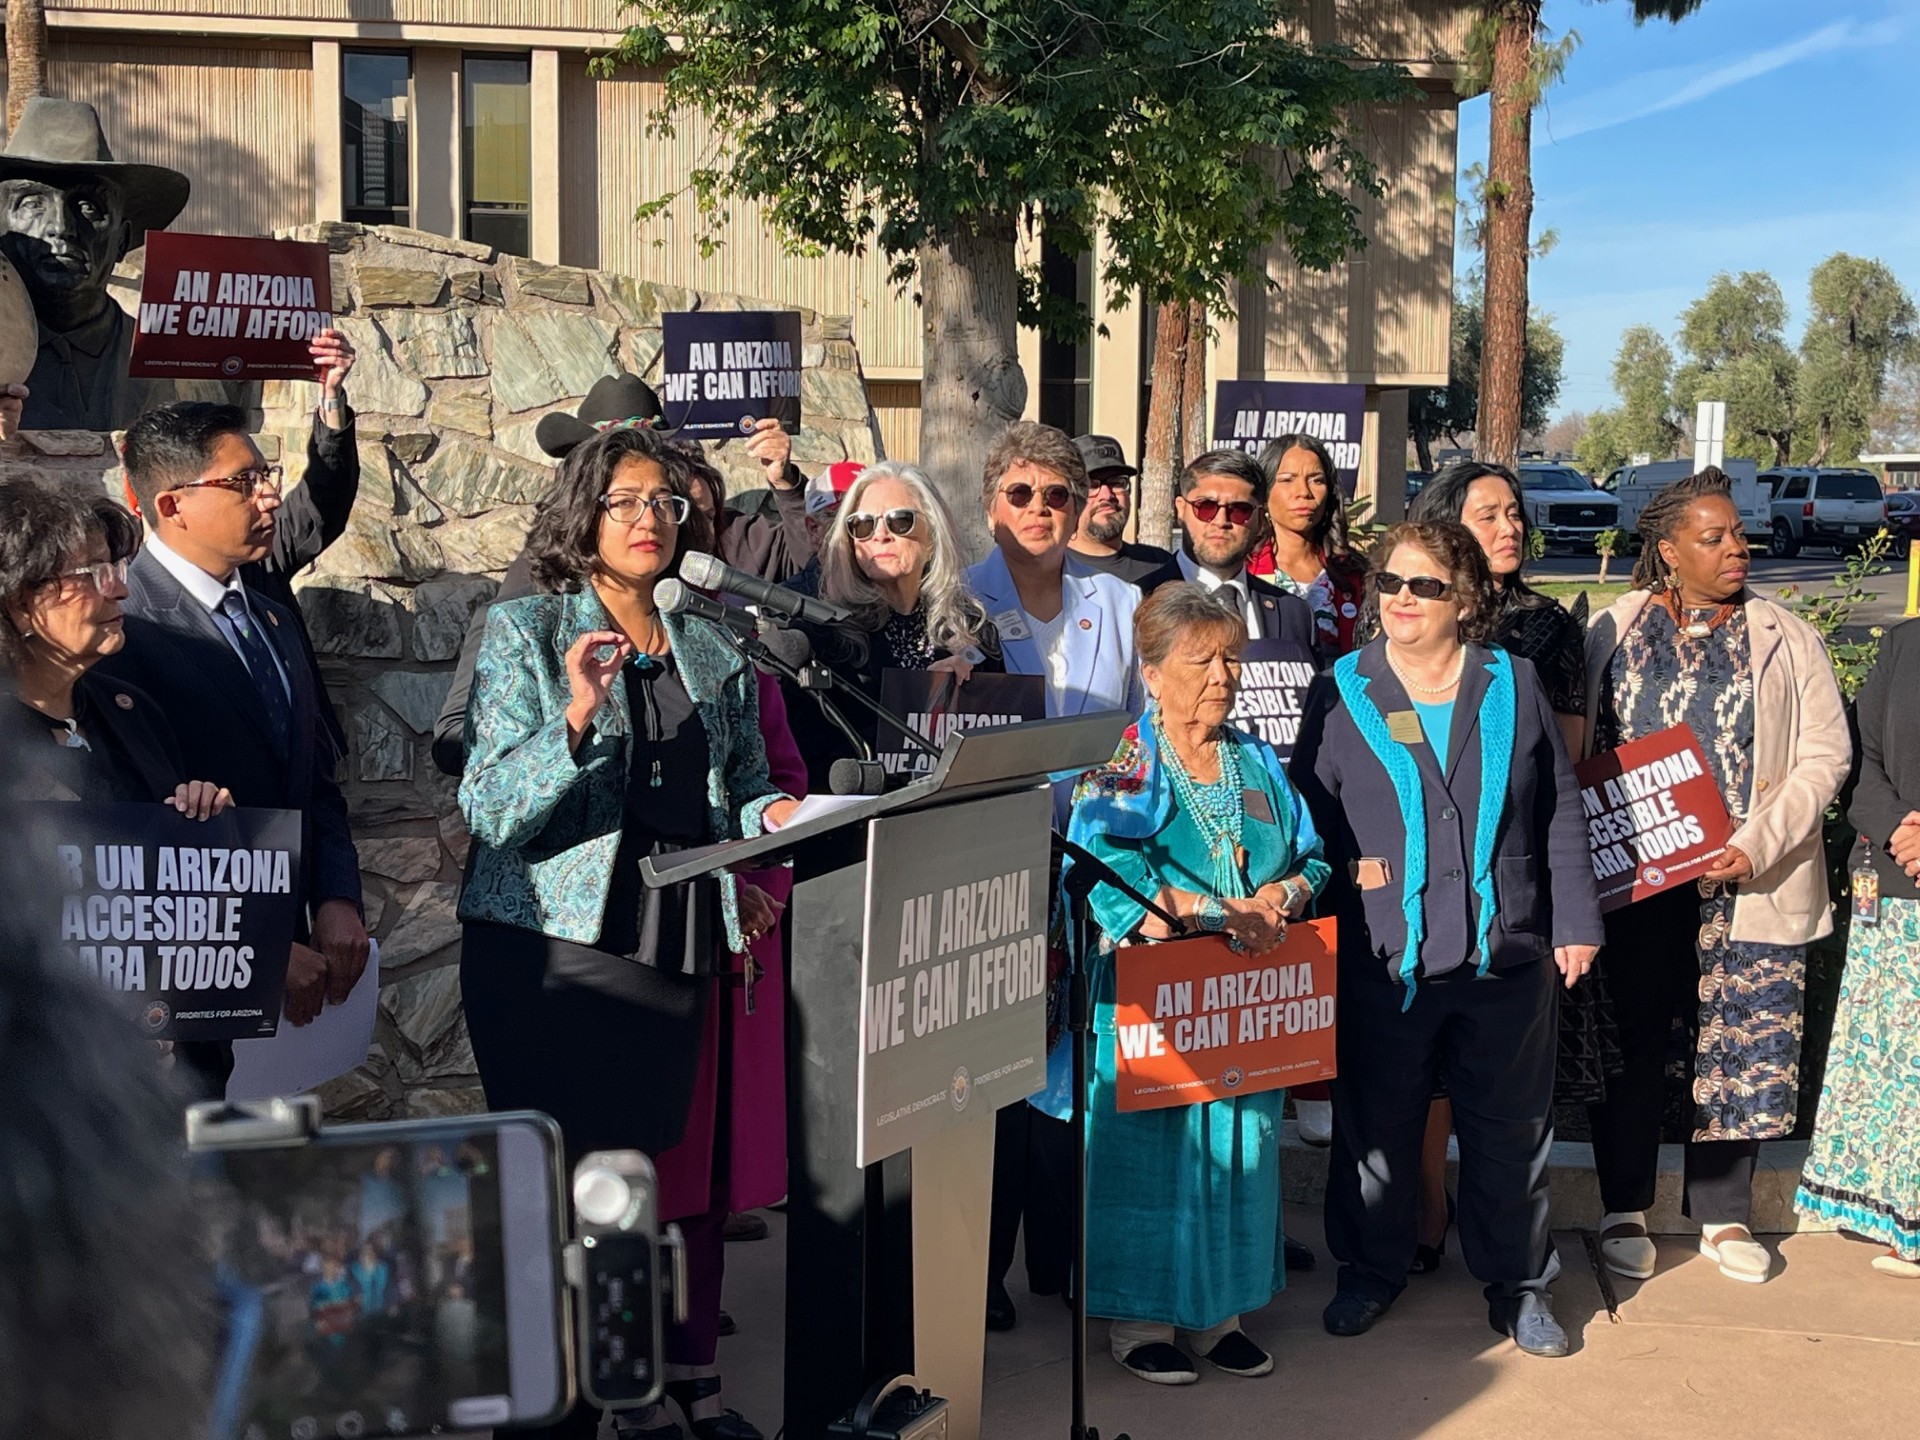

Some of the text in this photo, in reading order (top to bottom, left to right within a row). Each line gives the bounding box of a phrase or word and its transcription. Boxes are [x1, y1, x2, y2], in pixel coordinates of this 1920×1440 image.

[173, 270, 316, 308] AN ARIZONA
[139, 303, 182, 335] WE
[186, 306, 240, 338] CAN
[689, 341, 792, 370] AN ARIZONA
[664, 370, 801, 401] WE CAN AFFORD
[1233, 410, 1346, 441] AN ARIZONA
[903, 713, 932, 750] AN
[1603, 748, 1703, 809] ARIZONA
[95, 845, 145, 890] UN
[156, 846, 290, 893] ARIZONA
[1591, 843, 1636, 880] ARA
[1628, 814, 1705, 864] TODOS
[61, 895, 243, 941] ACCESIBLE
[898, 869, 1030, 968] AN ARIZONA
[157, 946, 255, 990] TODOS
[1154, 962, 1314, 1019] AN ARIZONA
[175, 1008, 263, 1019] PRIORITIES FOR ARIZONA
[867, 934, 1046, 1054] WE CAN AFFORD
[1118, 994, 1335, 1060] WE CAN AFFORD
[876, 1103, 913, 1127] LEGISLATIVE
[973, 1069, 1002, 1087] PRIORITIES
[1001, 1064, 1012, 1076] FOR
[1012, 1056, 1035, 1072] ARIZONA
[1134, 1084, 1176, 1096] LEGISLATIVE
[1248, 1066, 1281, 1077] PRIORITIES
[1281, 1064, 1294, 1072] FOR
[1294, 1059, 1321, 1069] ARIZONA
